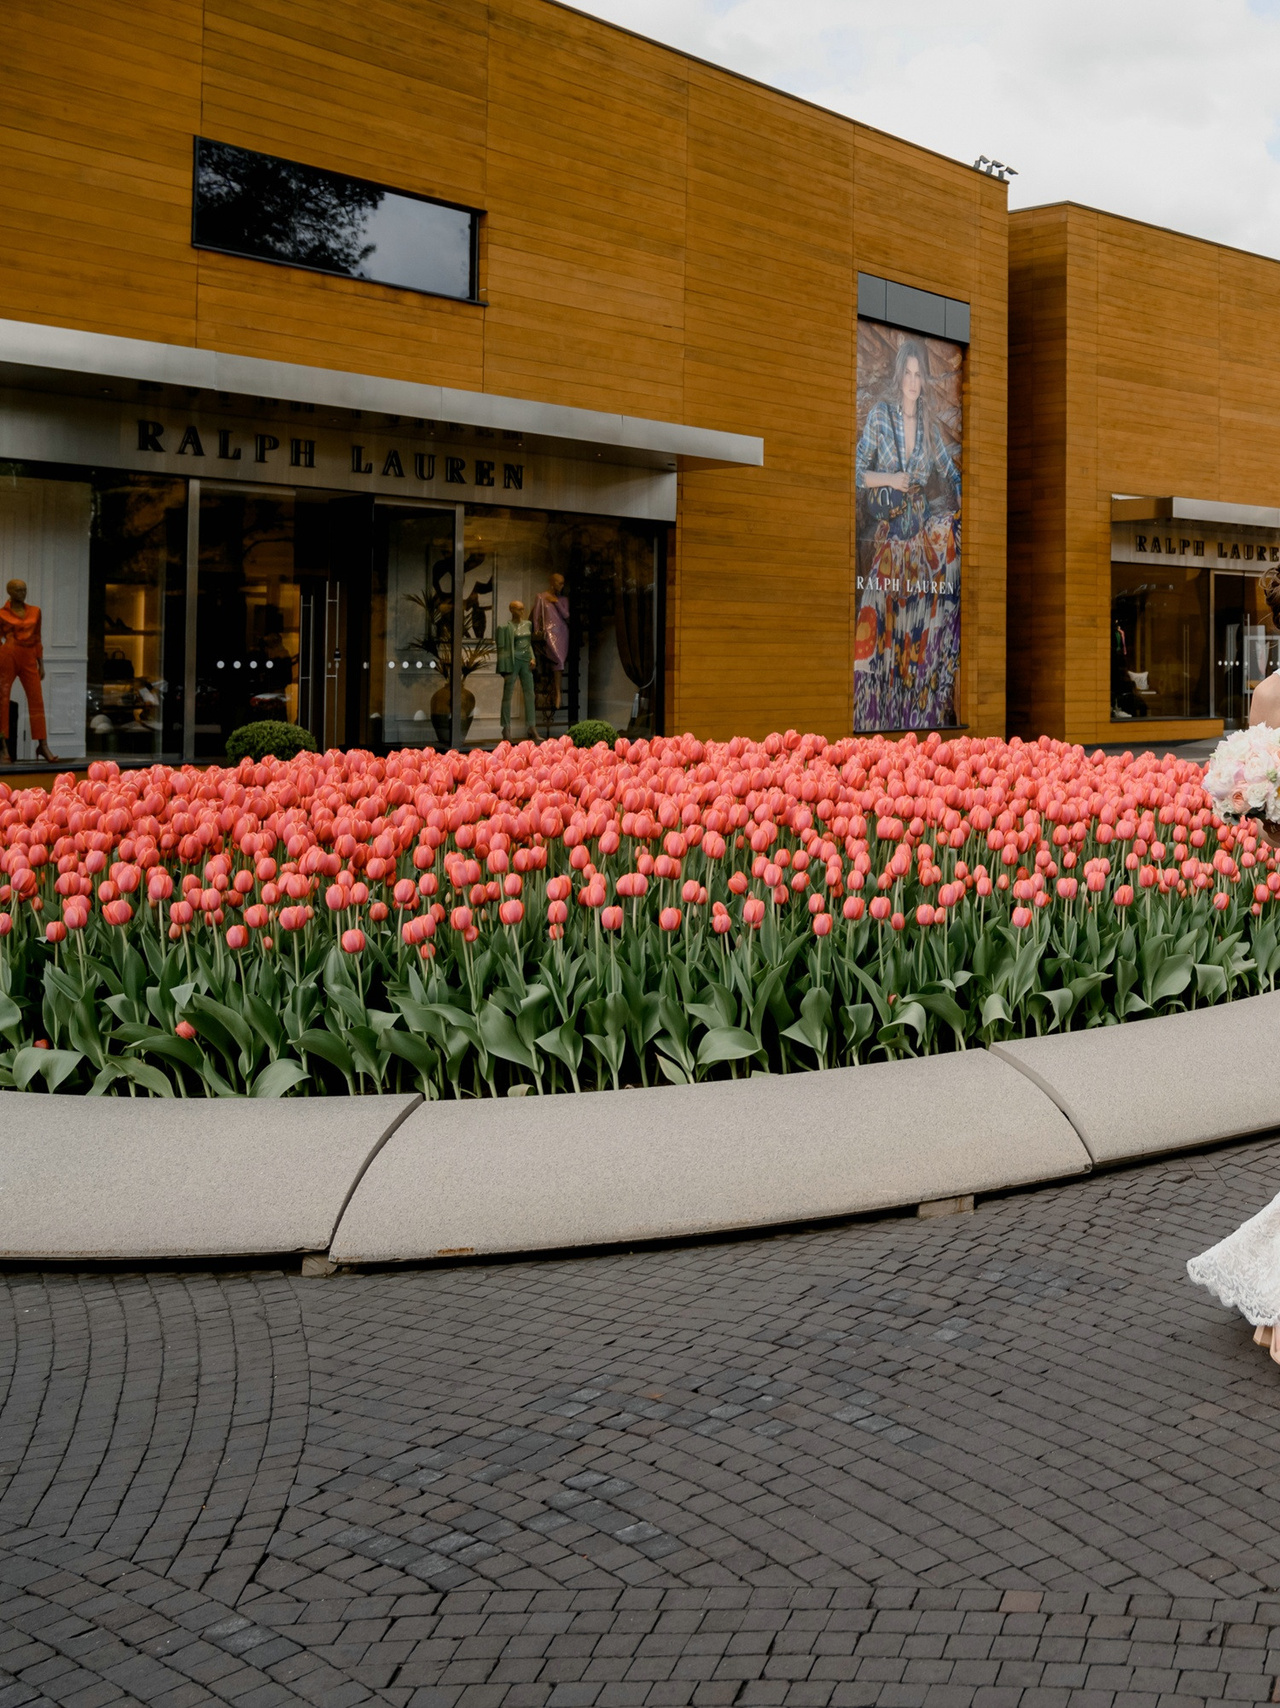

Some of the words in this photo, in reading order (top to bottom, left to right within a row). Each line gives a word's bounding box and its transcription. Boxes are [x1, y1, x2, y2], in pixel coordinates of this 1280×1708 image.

[137, 420, 317, 468] RALPH
[351, 445, 525, 490] LAUREN
[1135, 535, 1205, 557] RALPH
[856, 575, 900, 592] RALPH
[906, 578, 955, 595] LAUREN
